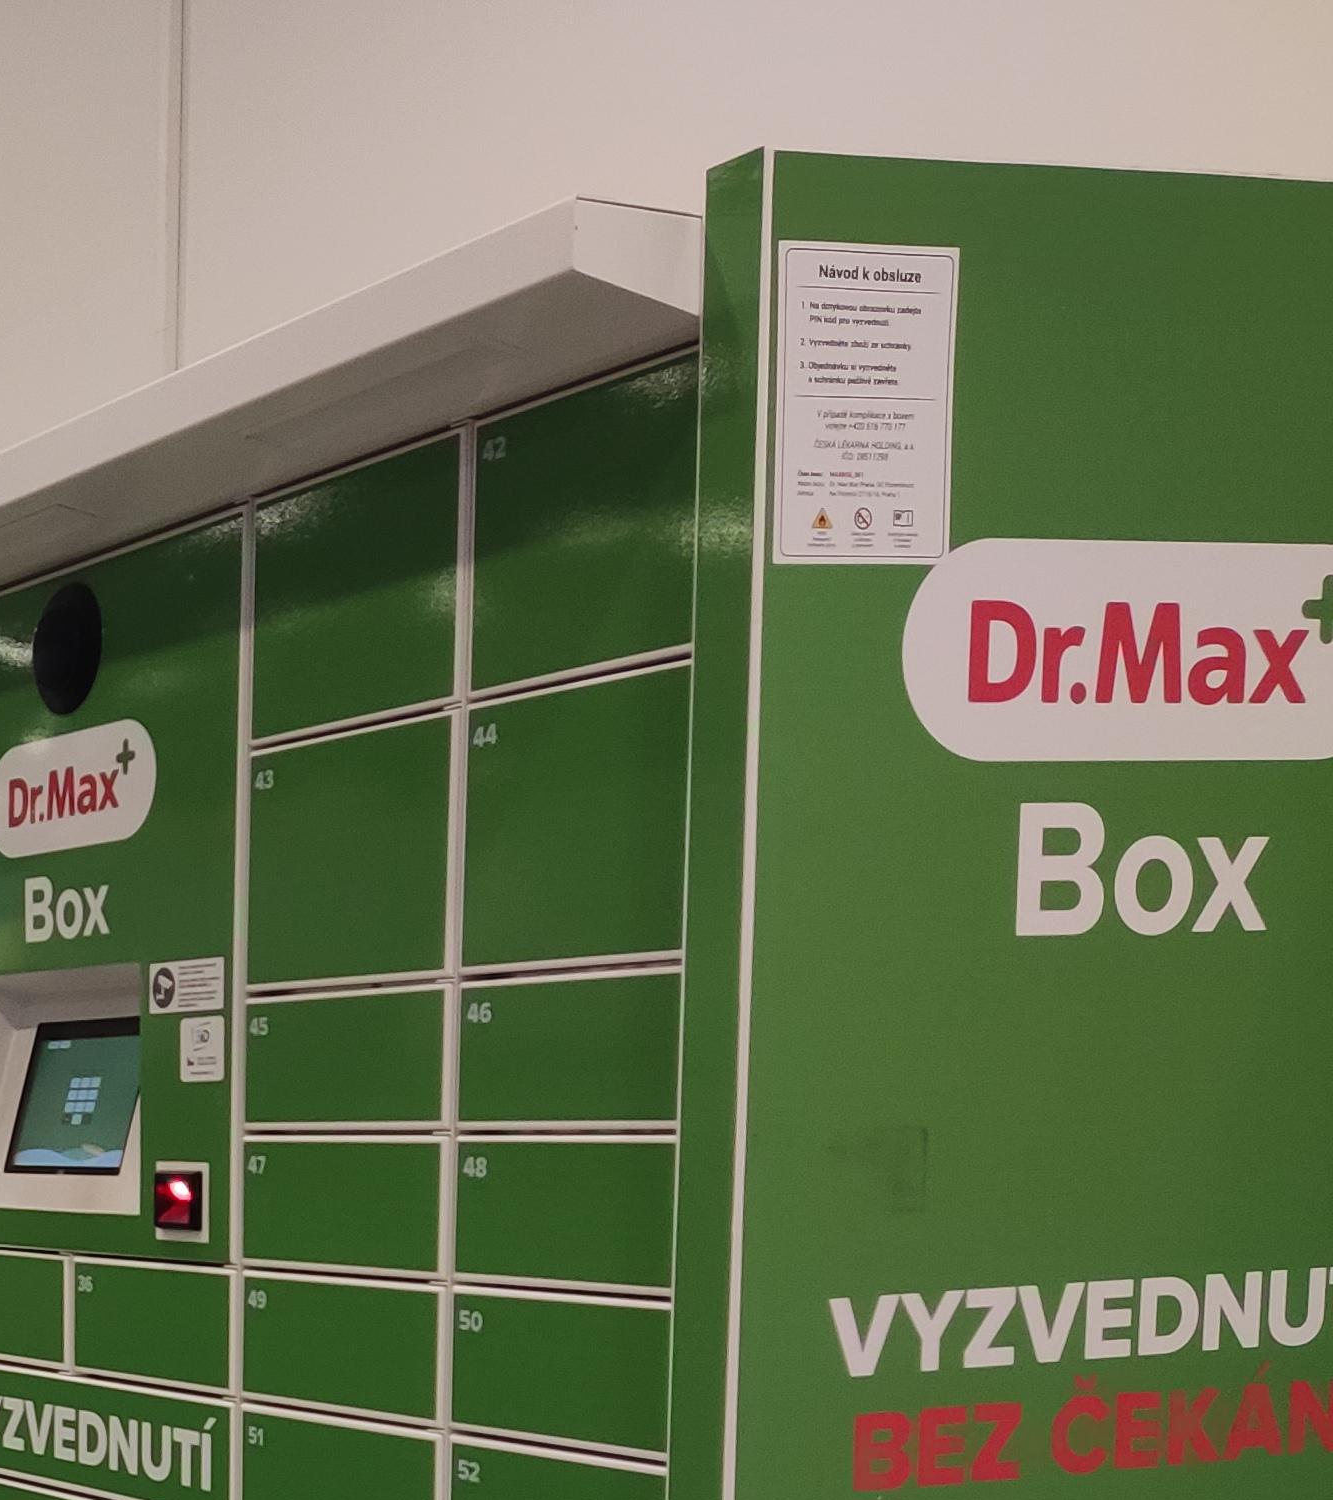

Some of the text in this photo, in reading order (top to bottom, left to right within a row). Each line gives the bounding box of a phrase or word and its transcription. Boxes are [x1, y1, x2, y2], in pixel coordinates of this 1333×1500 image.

[819, 264, 922, 283] Návod k obsluze
[809, 315, 822, 323] PIN
[838, 317, 850, 326] pro
[482, 436, 507, 461] 42
[966, 599, 1309, 705] Dr.Max
[472, 723, 497, 747] 44
[254, 769, 274, 790] 43
[7, 762, 119, 829] Dr.Max
[1016, 802, 1270, 937] Box
[24, 875, 110, 943] Box
[467, 1002, 492, 1023] 46
[249, 1016, 269, 1036] 45
[247, 1155, 266, 1175] 47
[462, 1156, 487, 1178] 48
[247, 1290, 267, 1309] 49
[458, 1309, 483, 1332] 50
[829, 1266, 1333, 1378] VYZVEDNU
[247, 1426, 264, 1447] 51
[853, 1402, 1023, 1492] BEZ
[457, 1459, 481, 1483] 52
